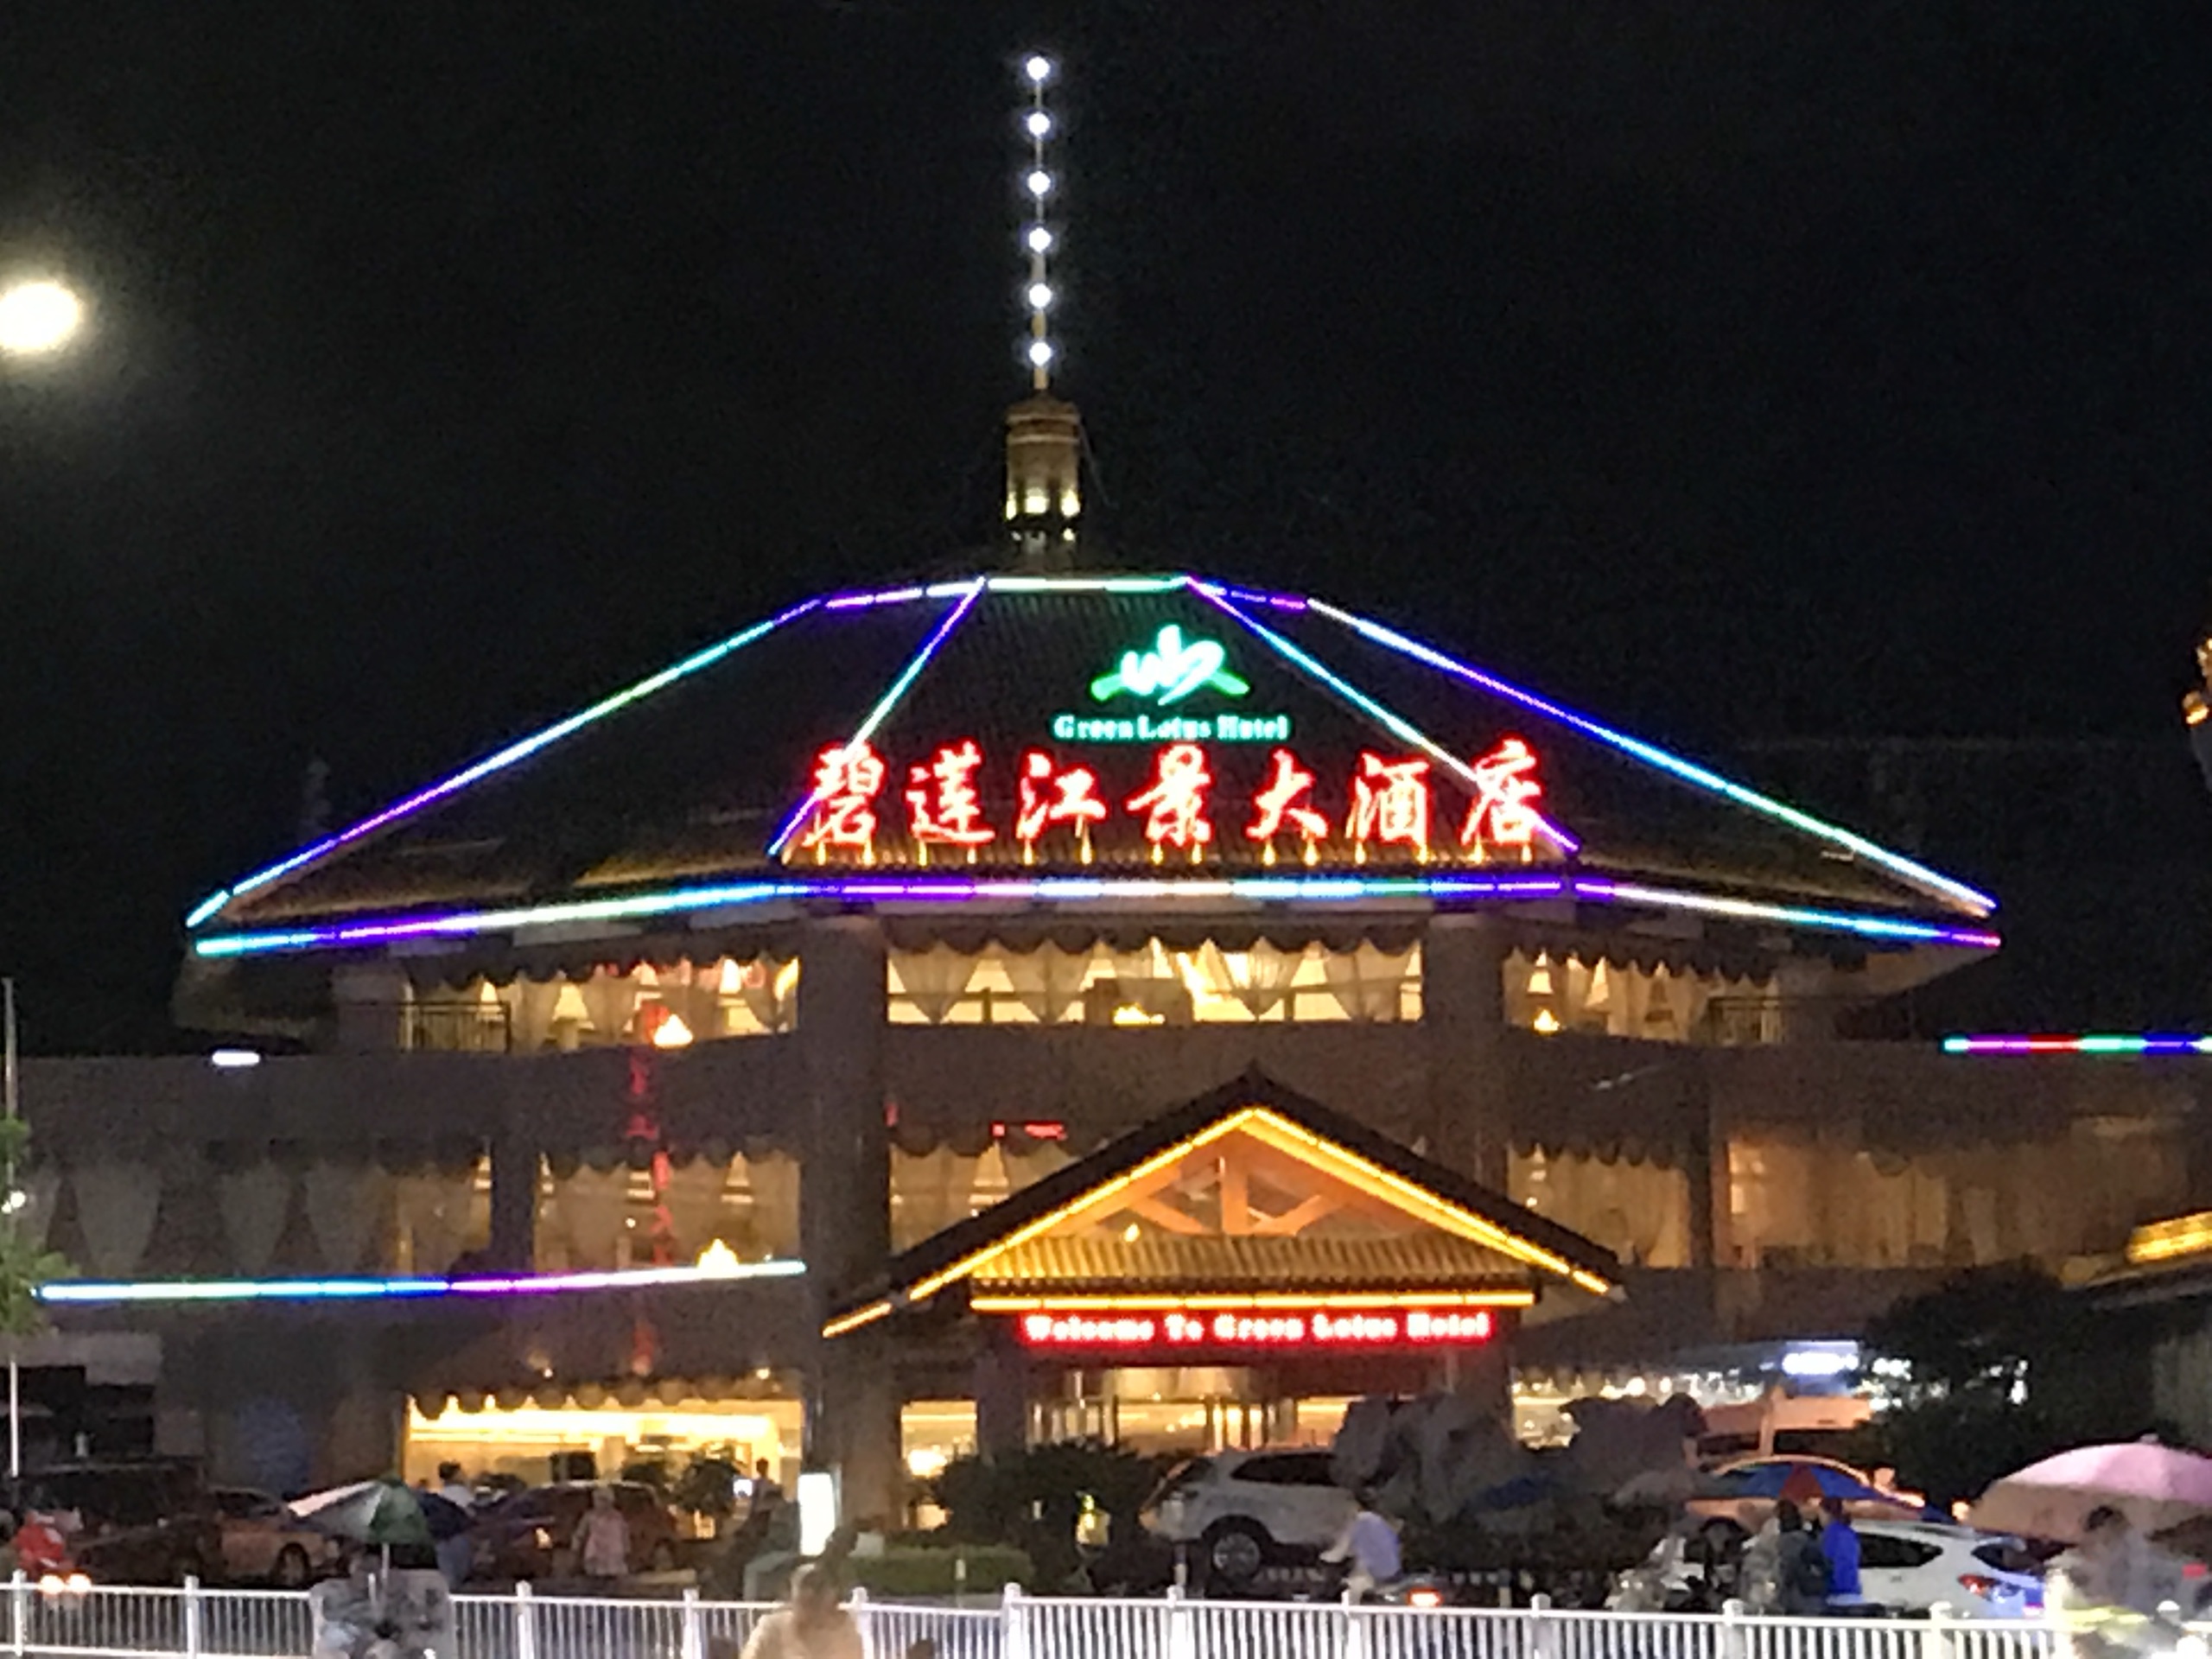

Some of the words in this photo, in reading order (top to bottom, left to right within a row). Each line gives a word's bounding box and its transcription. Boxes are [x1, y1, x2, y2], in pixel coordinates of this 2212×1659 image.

[1052, 714, 1135, 739] Green
[1136, 714, 1211, 739] Lotus
[1217, 714, 1289, 739] Hotel
[1024, 1313, 1156, 1341] Welcome
[1163, 1313, 1205, 1341] To
[1212, 1313, 1305, 1341] Green
[1312, 1313, 1397, 1341] Lotus
[1406, 1311, 1491, 1340] Hotel
